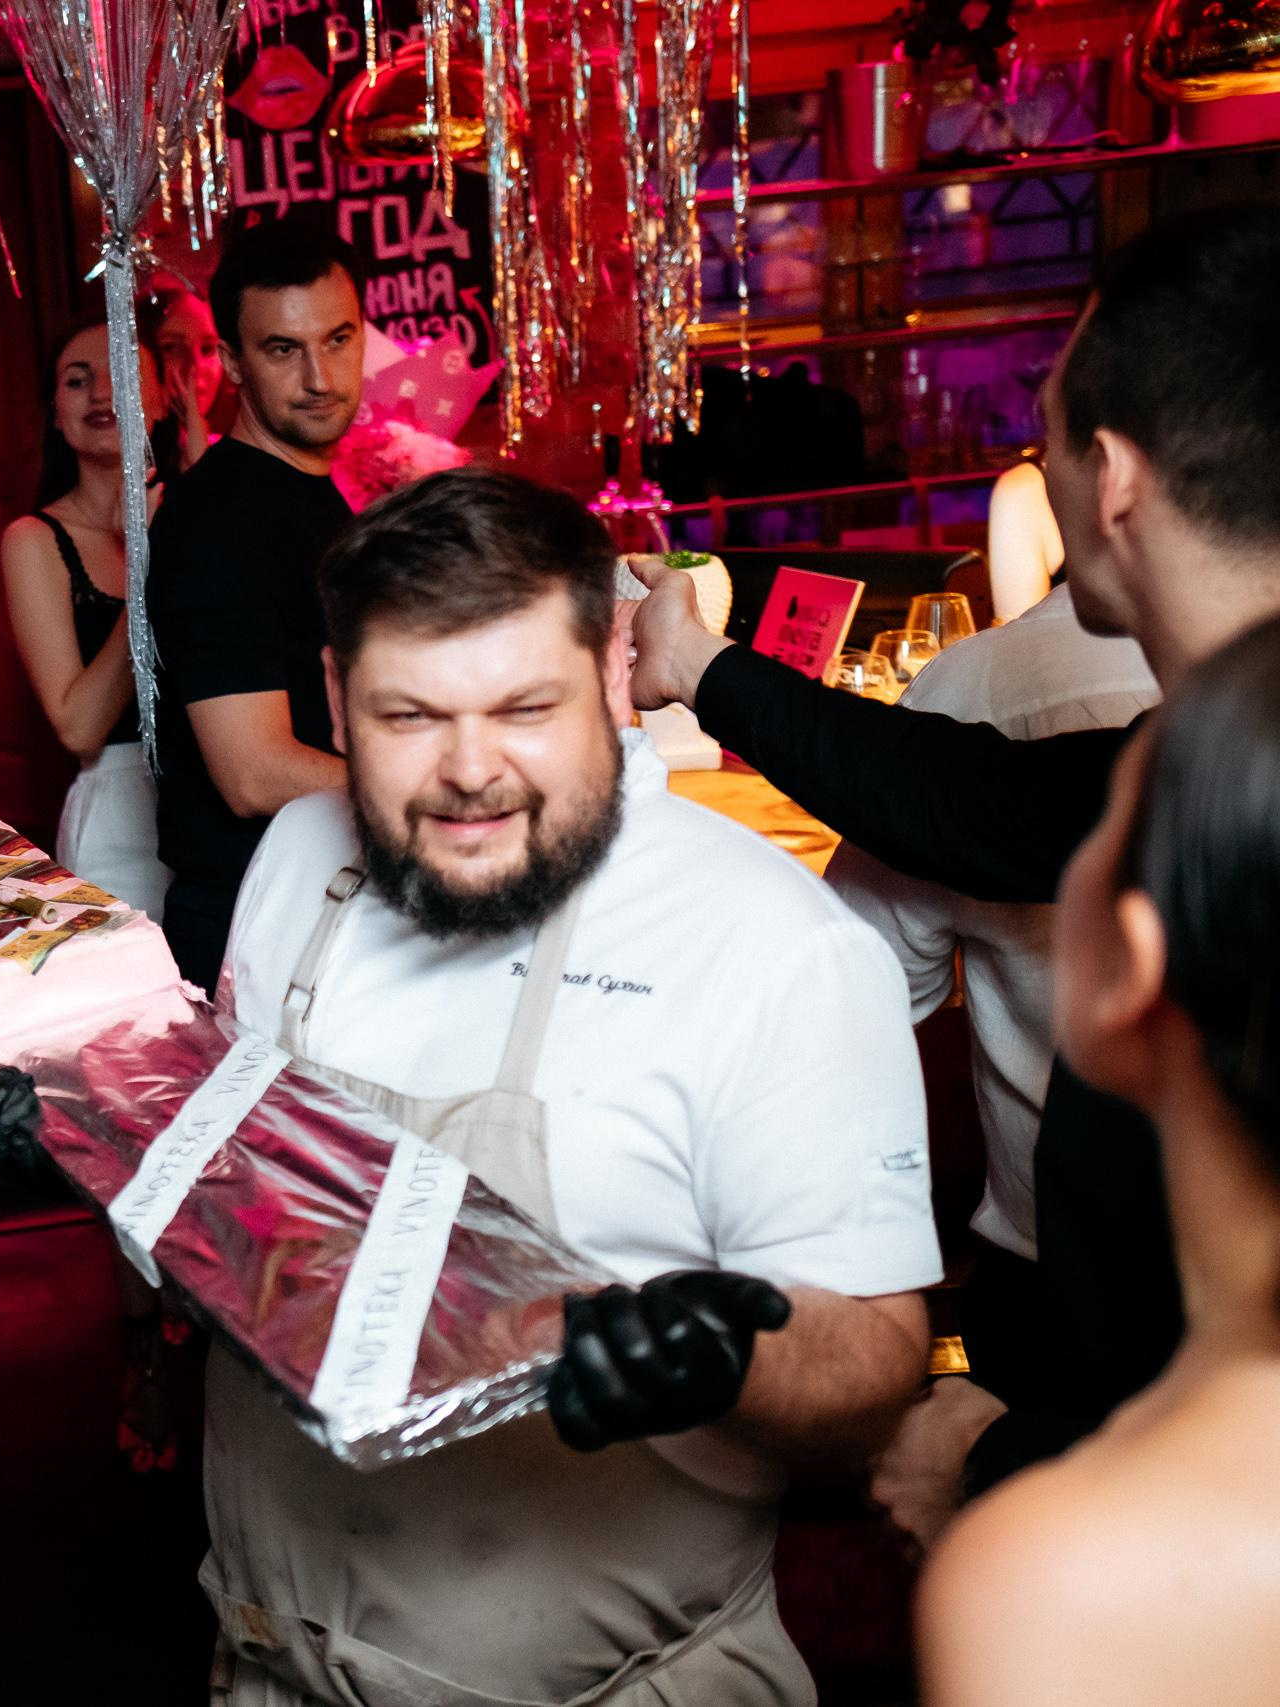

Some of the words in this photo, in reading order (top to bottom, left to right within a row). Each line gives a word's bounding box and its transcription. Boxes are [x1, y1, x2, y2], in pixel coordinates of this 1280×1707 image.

[337, 190, 471, 262] ГОД
[365, 262, 458, 319] ЮНЯ
[340, 1269, 412, 1400] INOTEKA
